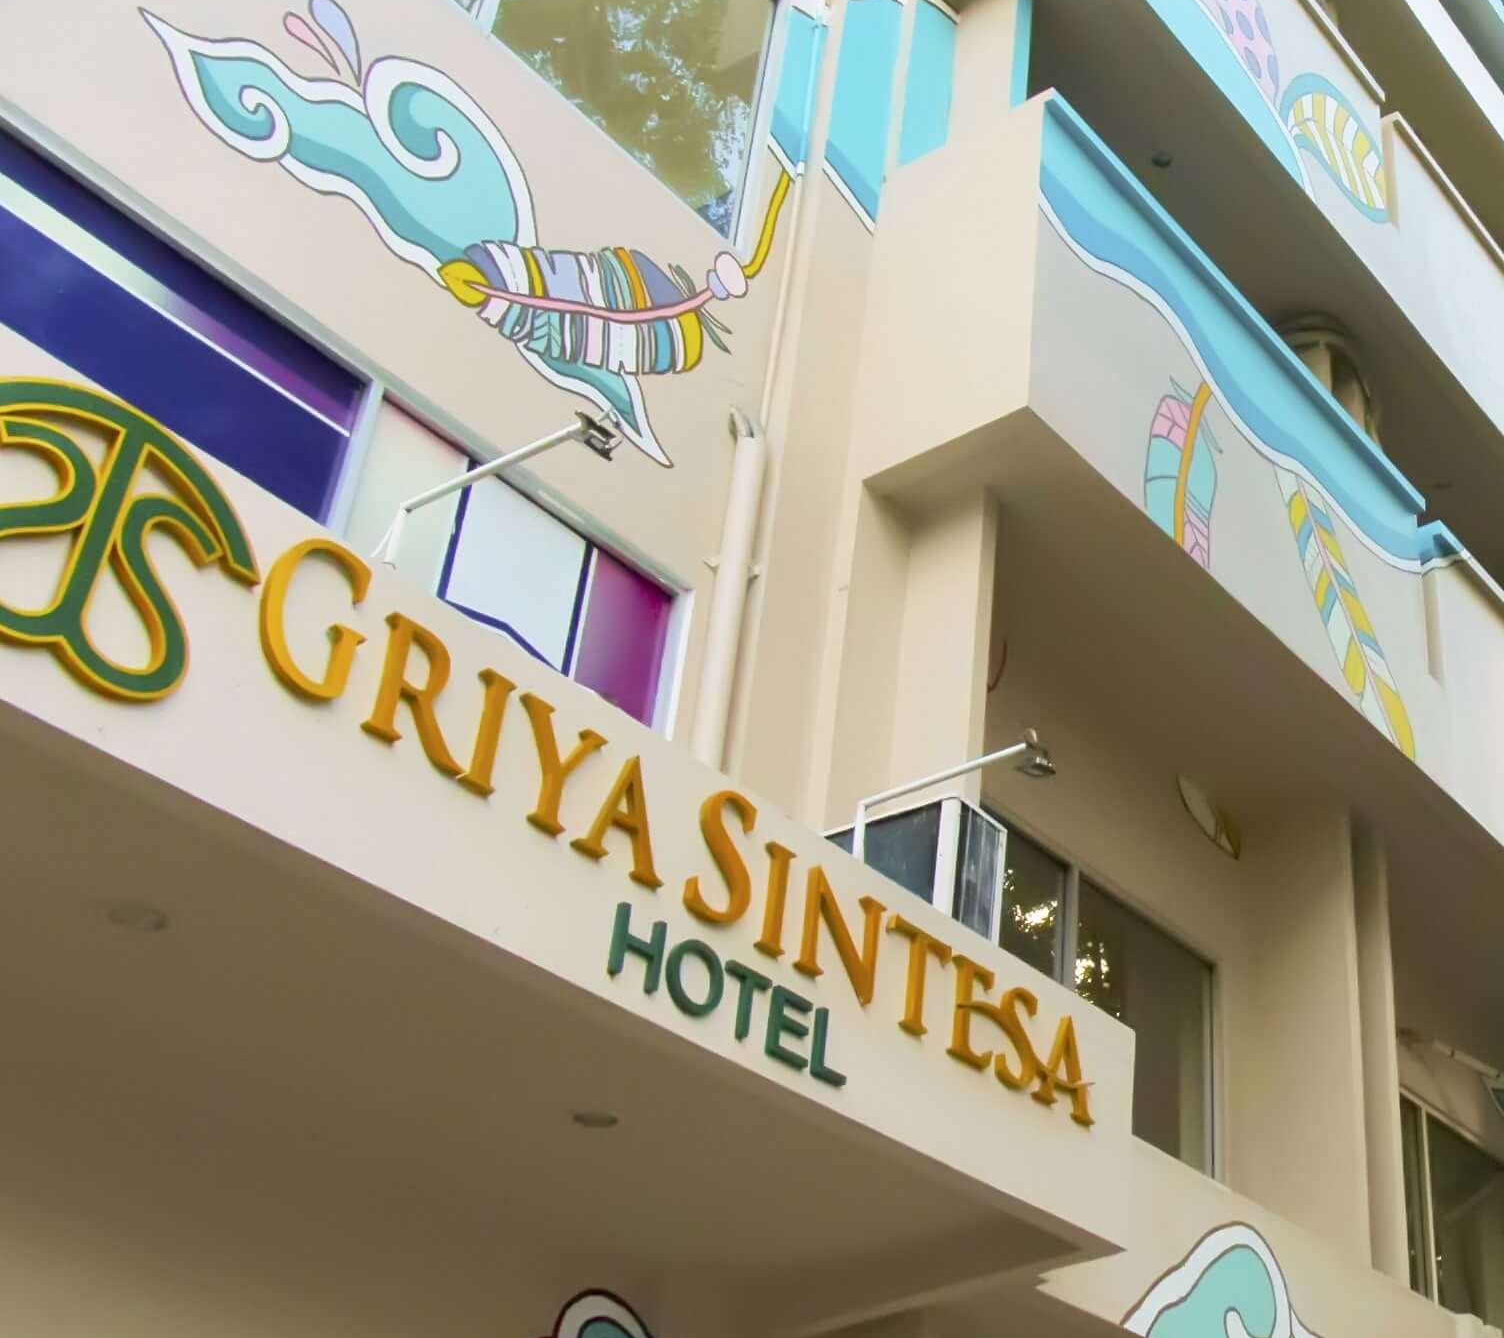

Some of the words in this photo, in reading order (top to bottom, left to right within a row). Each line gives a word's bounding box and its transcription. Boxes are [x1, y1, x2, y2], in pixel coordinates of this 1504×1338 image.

[259, 538, 664, 890] GRIYA
[684, 790, 1095, 1126] SINTESA
[607, 902, 846, 1088] HOTEL
